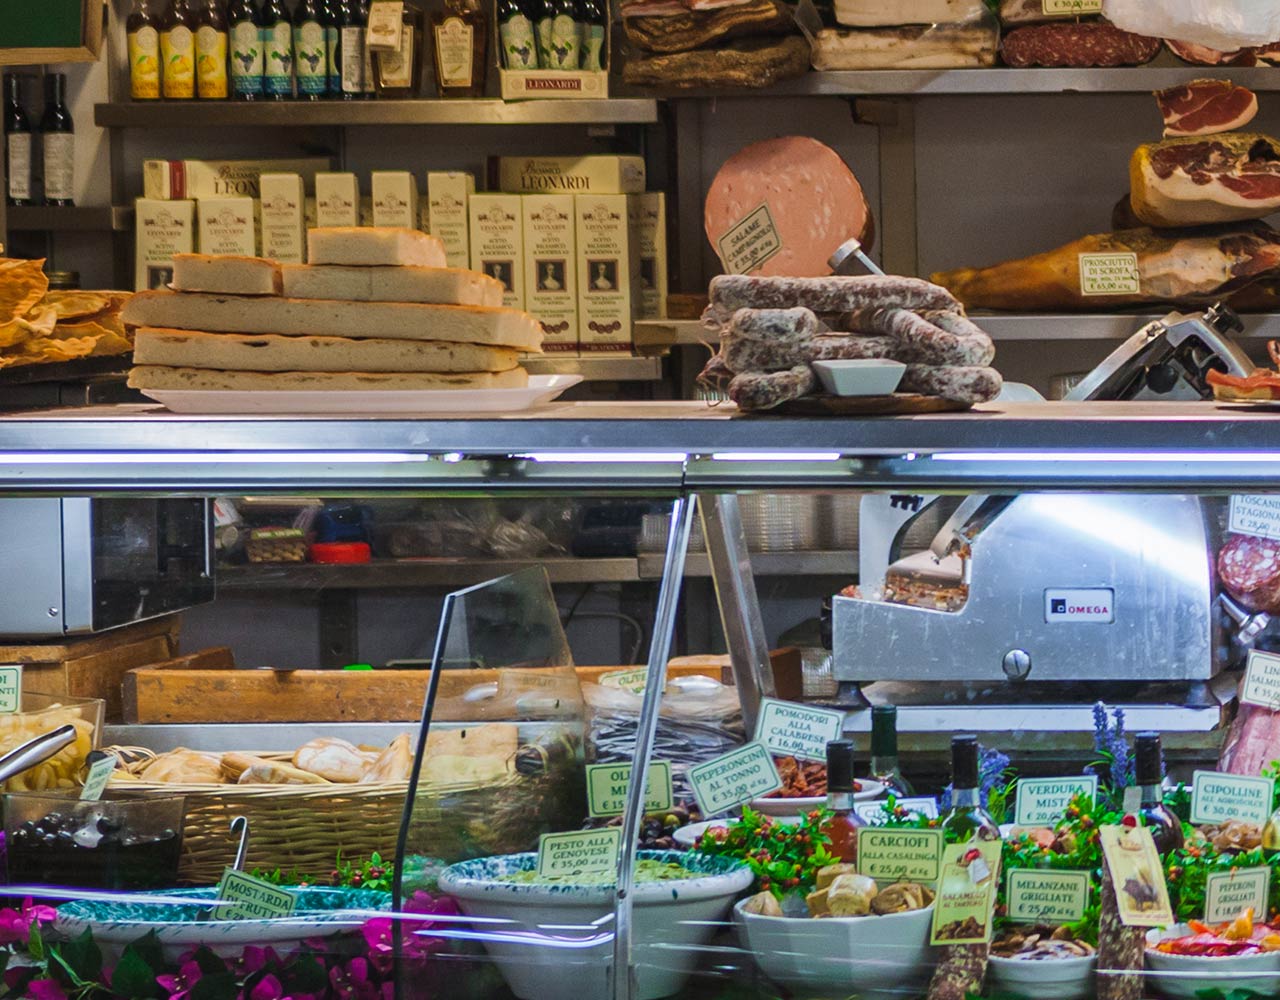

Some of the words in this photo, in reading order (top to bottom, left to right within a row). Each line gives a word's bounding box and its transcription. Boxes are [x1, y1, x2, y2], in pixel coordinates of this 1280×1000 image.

[528, 79, 580, 89] LEONARDI
[521, 175, 590, 189] LEONARDI
[730, 218, 761, 248] SALAME
[728, 224, 773, 264] CAMPAGNOLO
[1084, 259, 1134, 267] PROSCIUTTO
[1099, 267, 1129, 276] SCROFA
[1068, 606, 1108, 614] OMEGA
[775, 706, 828, 725] POMODORI
[788, 720, 811, 731] ALLA
[771, 726, 826, 745] CALABRESE
[778, 738, 803, 750] 16,00
[695, 750, 766, 784] PEPERONCINI
[709, 779, 721, 791] AL
[726, 765, 761, 785] TONNO
[722, 784, 748, 801] 35,00
[1028, 784, 1084, 796] VERDURA
[1203, 784, 1262, 798] CIPOLLINE
[1213, 806, 1239, 816] 30,00
[550, 840, 584, 851] PESTO
[587, 838, 614, 847] ALLA
[870, 836, 929, 848] CARCIOFI
[552, 847, 610, 859] GENOVESE
[862, 851, 883, 860] ALLA
[886, 852, 937, 861] CASALINGA
[561, 858, 588, 869] 35,00
[870, 863, 875, 872] €
[879, 864, 907, 875] 25,00
[1016, 880, 1079, 891] MELANZANE
[1219, 880, 1256, 892] PEPERONI
[227, 879, 288, 911] MOSTARDA
[1020, 893, 1074, 903] GRIGLIATE
[1217, 893, 1256, 904] GRIGLIATI
